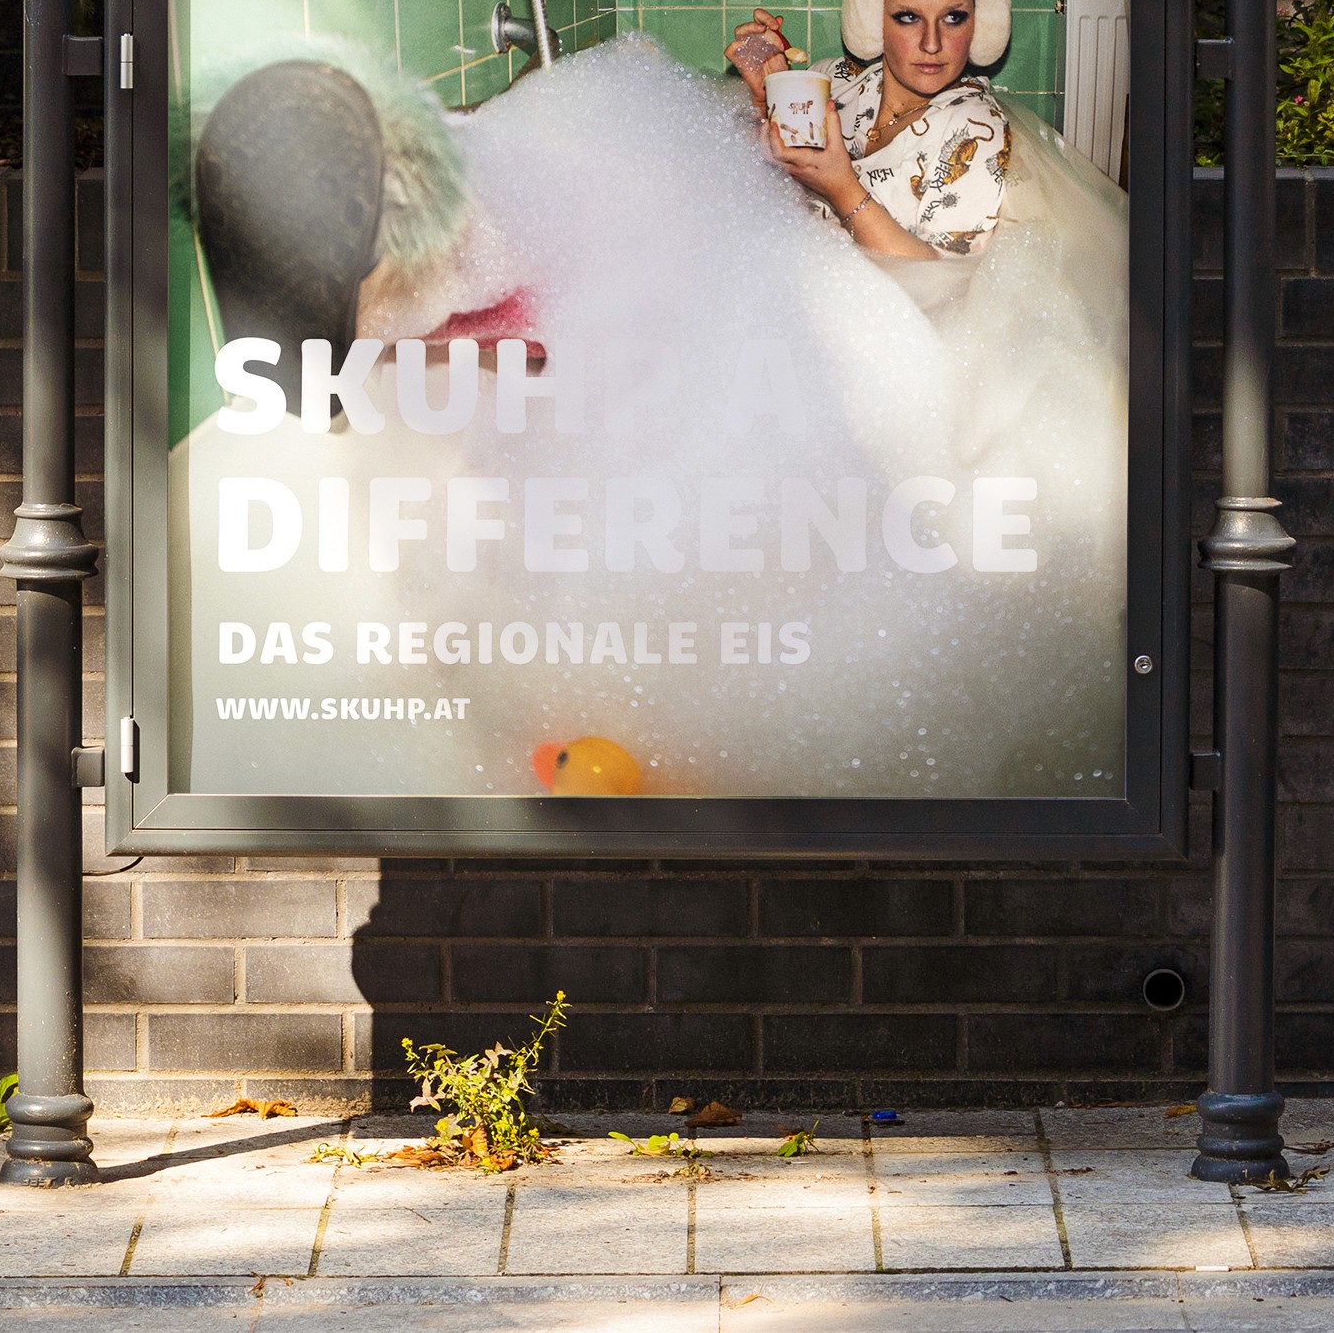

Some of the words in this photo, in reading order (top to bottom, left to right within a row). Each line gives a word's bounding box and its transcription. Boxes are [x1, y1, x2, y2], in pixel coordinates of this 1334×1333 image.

[214, 336, 687, 437] SKUHP
[218, 476, 1038, 573] DIFFERENCE
[219, 621, 334, 665] DAS
[357, 621, 697, 665] REGIONALE
[720, 621, 811, 665] EIS
[216, 697, 471, 720] WWW.SKUHP.AT
